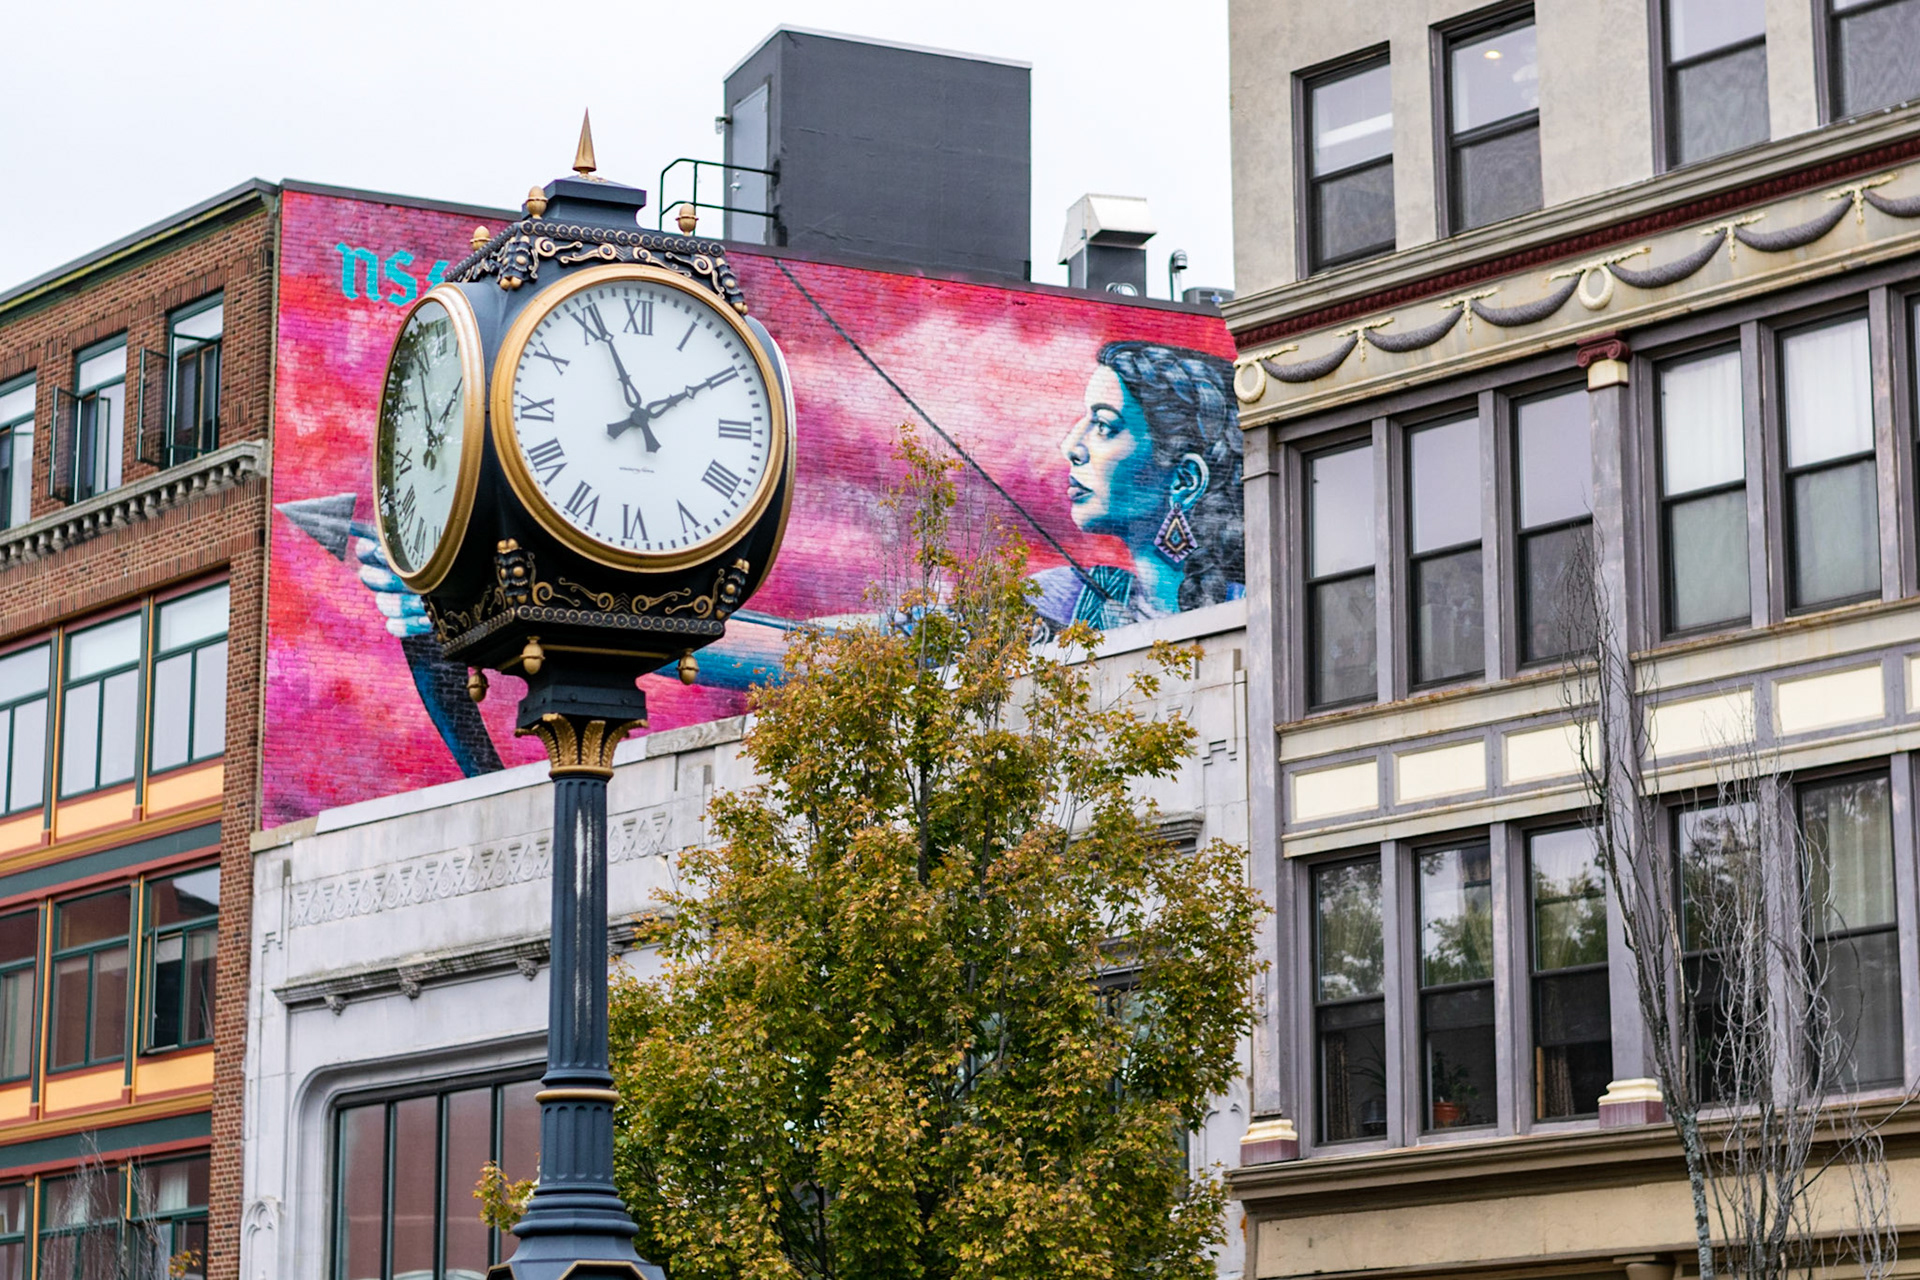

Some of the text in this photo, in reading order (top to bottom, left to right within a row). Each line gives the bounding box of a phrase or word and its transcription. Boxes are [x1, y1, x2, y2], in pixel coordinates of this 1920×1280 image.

[569, 304, 605, 346] XI
[622, 298, 654, 336] XII
[676, 321, 698, 352] I
[533, 341, 570, 375] X
[705, 365, 740, 390] II
[520, 394, 555, 422] IX
[718, 418, 752, 441] III
[526, 438, 568, 487] VIII
[701, 459, 742, 500] IIII
[564, 480, 601, 528] VII
[622, 503, 649, 541] VI
[676, 499, 702, 534] V
